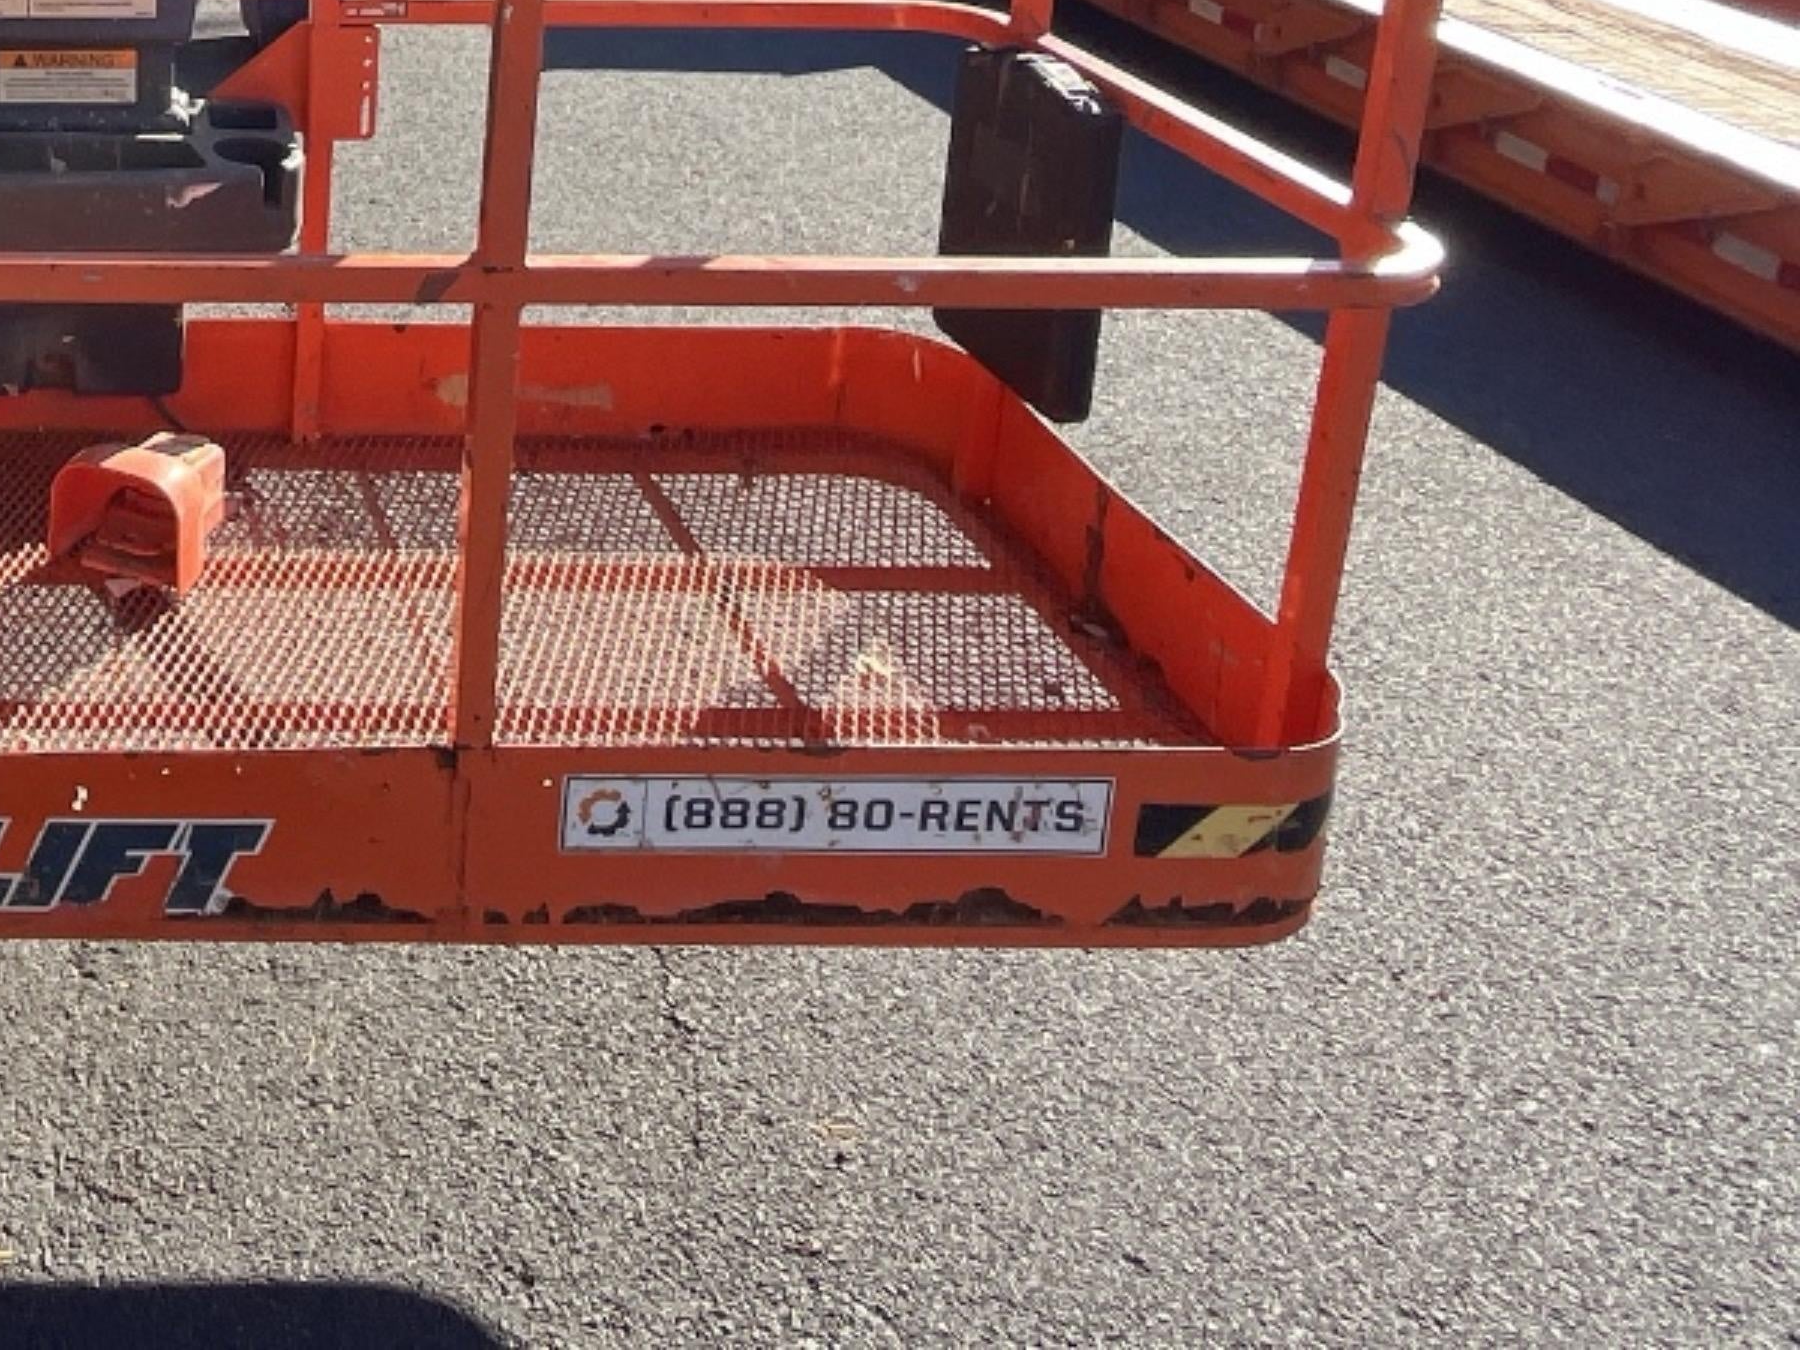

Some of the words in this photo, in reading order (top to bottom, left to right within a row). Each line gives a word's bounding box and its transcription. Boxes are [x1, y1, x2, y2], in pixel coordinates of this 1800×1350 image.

[32, 52, 116, 67] WARNING
[664, 794, 807, 832] (888)
[827, 797, 1086, 832] 80-RENTS
